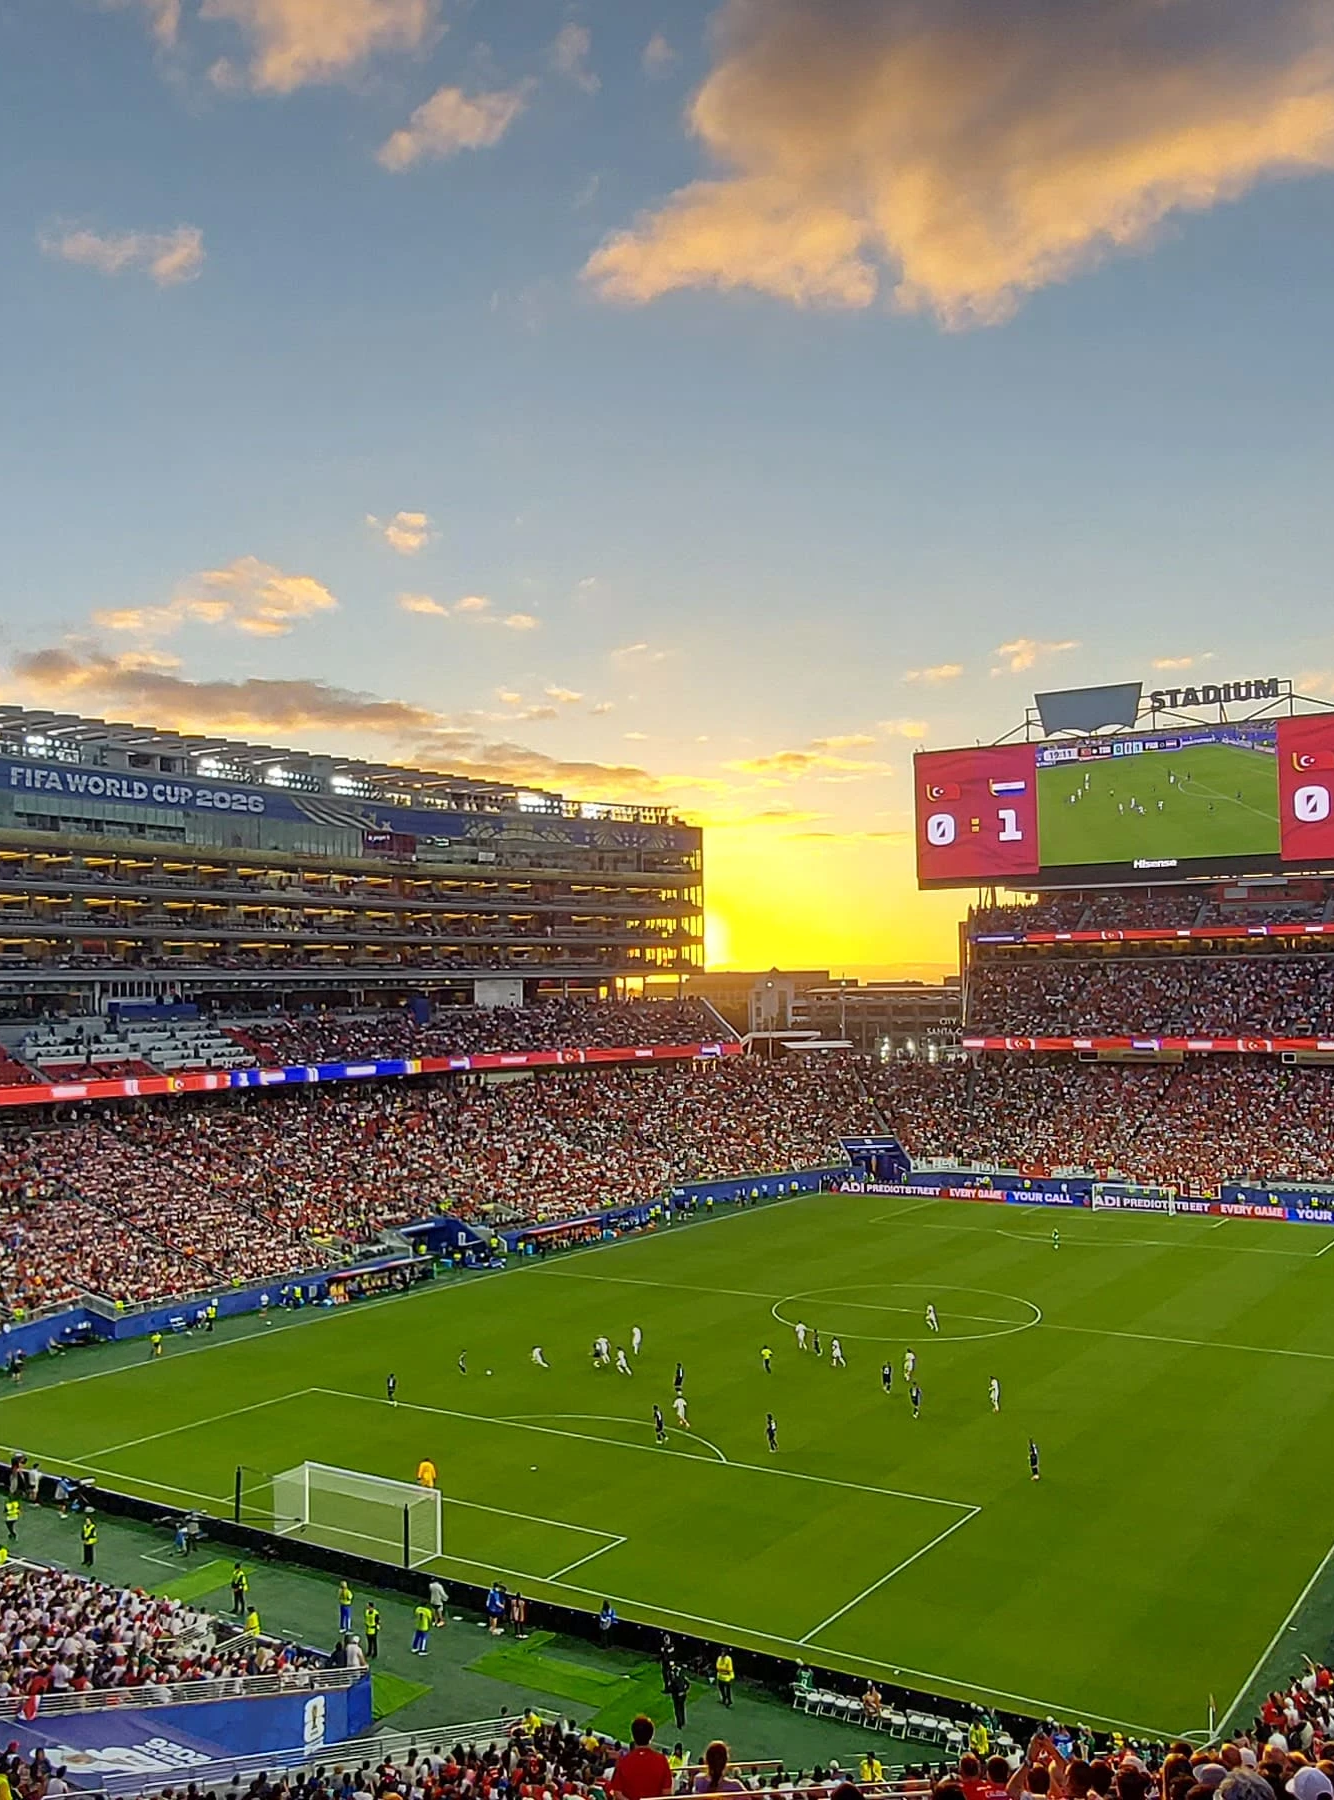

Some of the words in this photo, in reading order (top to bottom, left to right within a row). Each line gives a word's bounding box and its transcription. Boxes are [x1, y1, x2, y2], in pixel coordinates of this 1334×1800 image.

[1151, 678, 1278, 711] STADIUM
[10, 766, 64, 791] FIFA
[66, 773, 148, 800] WORLD
[152, 784, 193, 805] CUP
[195, 789, 265, 813] 2026
[1293, 785, 1331, 822] 0
[927, 813, 956, 846] 0
[998, 809, 1023, 842] 1
[1134, 858, 1178, 869] Hisense
[840, 1181, 865, 1193] ADI
[949, 1187, 977, 1200] EVERY
[1013, 1191, 1043, 1203] YOUR
[1044, 1192, 1074, 1204] CALL
[1095, 1194, 1121, 1208] ADI
[1220, 1203, 1254, 1217] EVERY
[1255, 1204, 1283, 1218] GAME
[1296, 1207, 1331, 1222] YOUR
